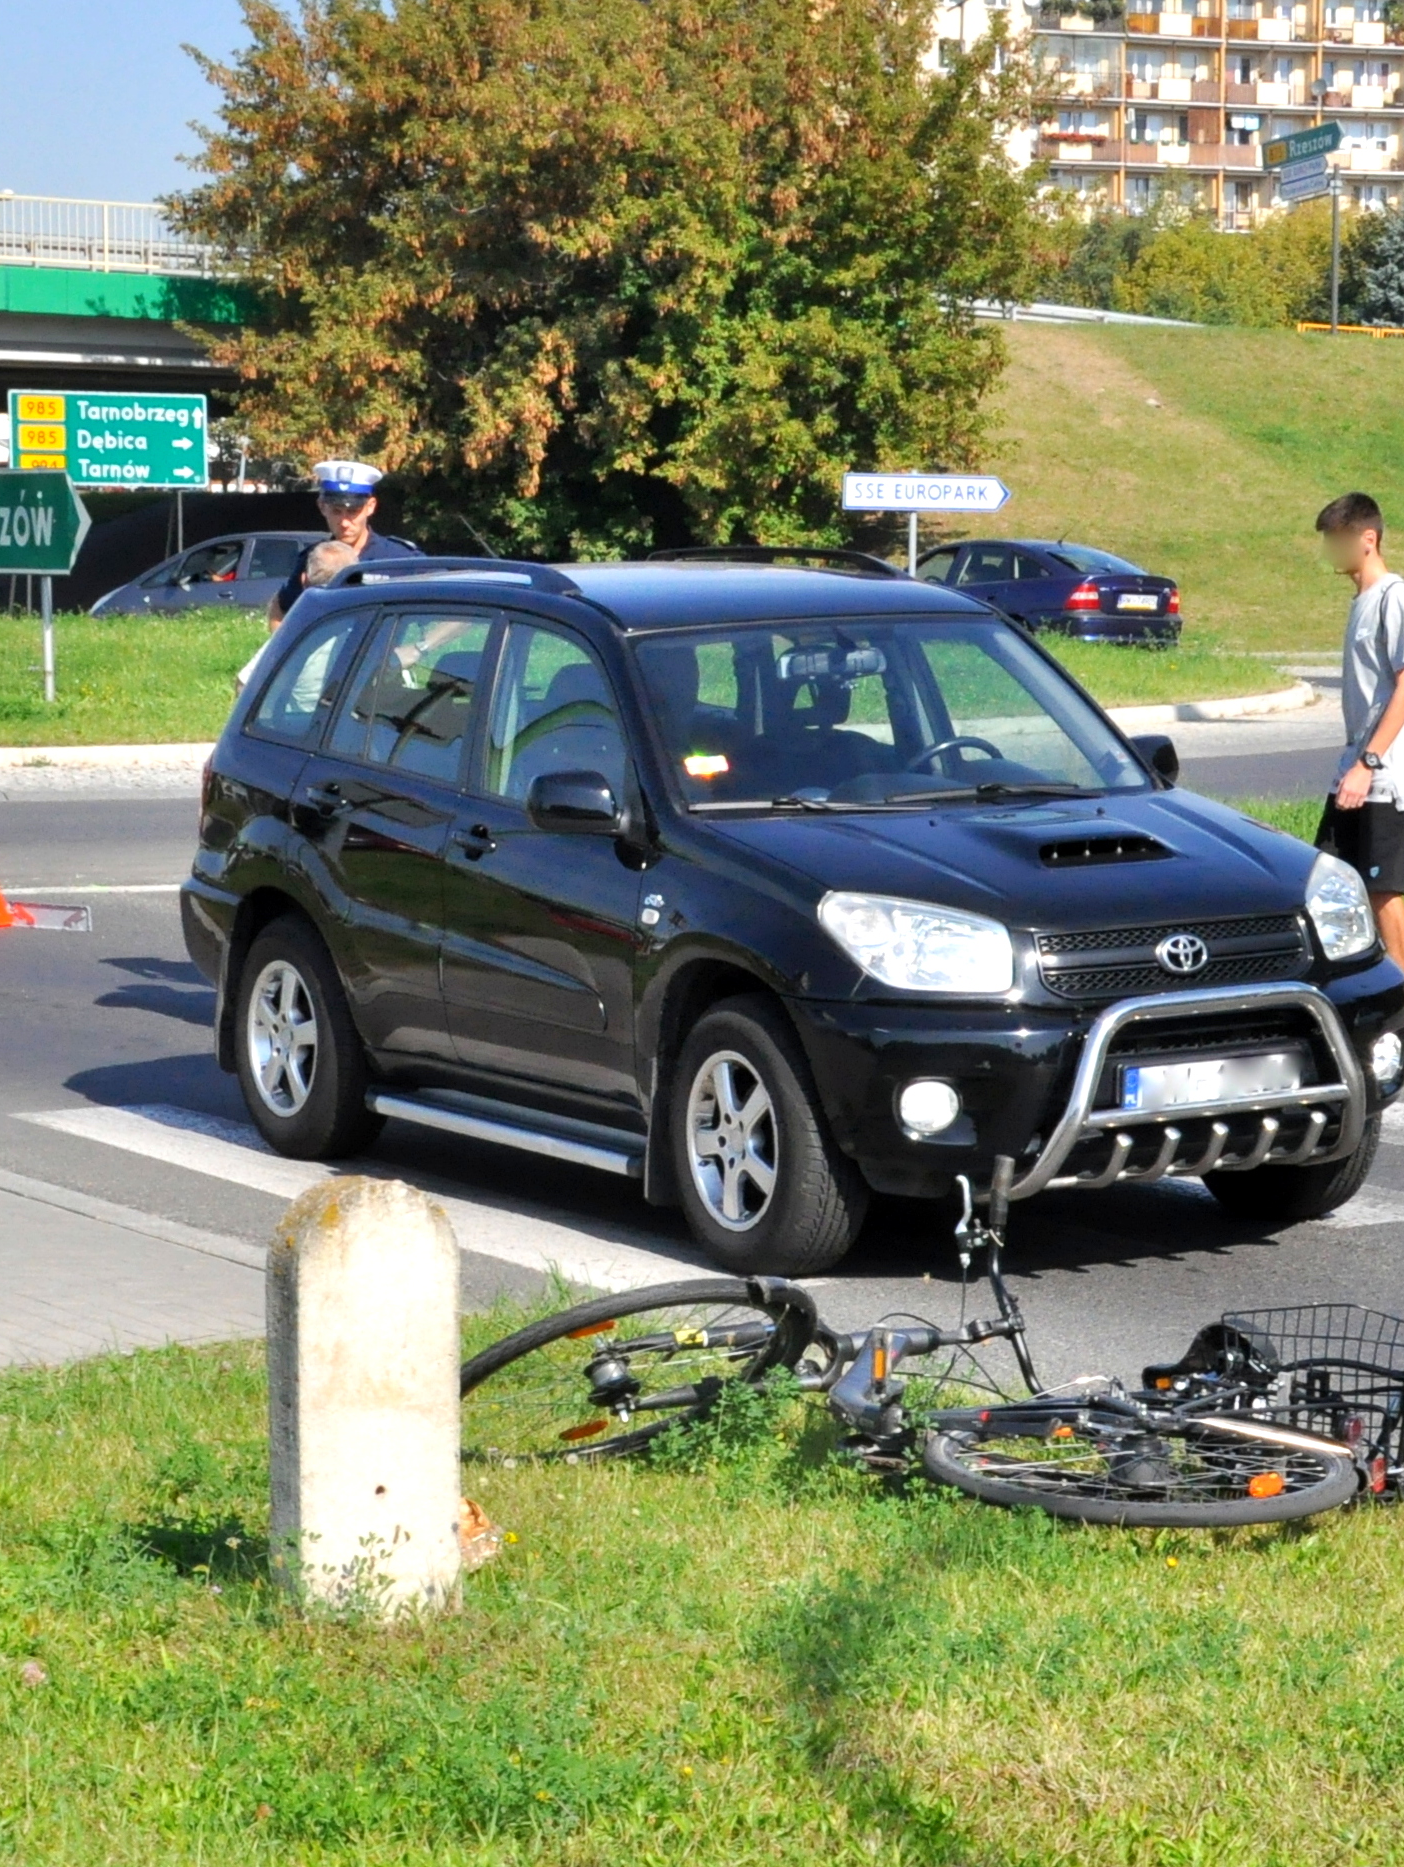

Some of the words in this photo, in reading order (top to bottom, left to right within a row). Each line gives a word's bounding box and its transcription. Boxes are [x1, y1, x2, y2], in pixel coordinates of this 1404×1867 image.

[1289, 131, 1332, 157] Rzeszów
[26, 401, 56, 416] 985
[77, 401, 189, 427] Tarnobrzeg
[27, 430, 57, 444] 985
[77, 429, 148, 454] Dębica
[78, 459, 151, 478] Tarnów
[854, 482, 885, 499] SSE
[895, 483, 988, 501] EUROPARK
